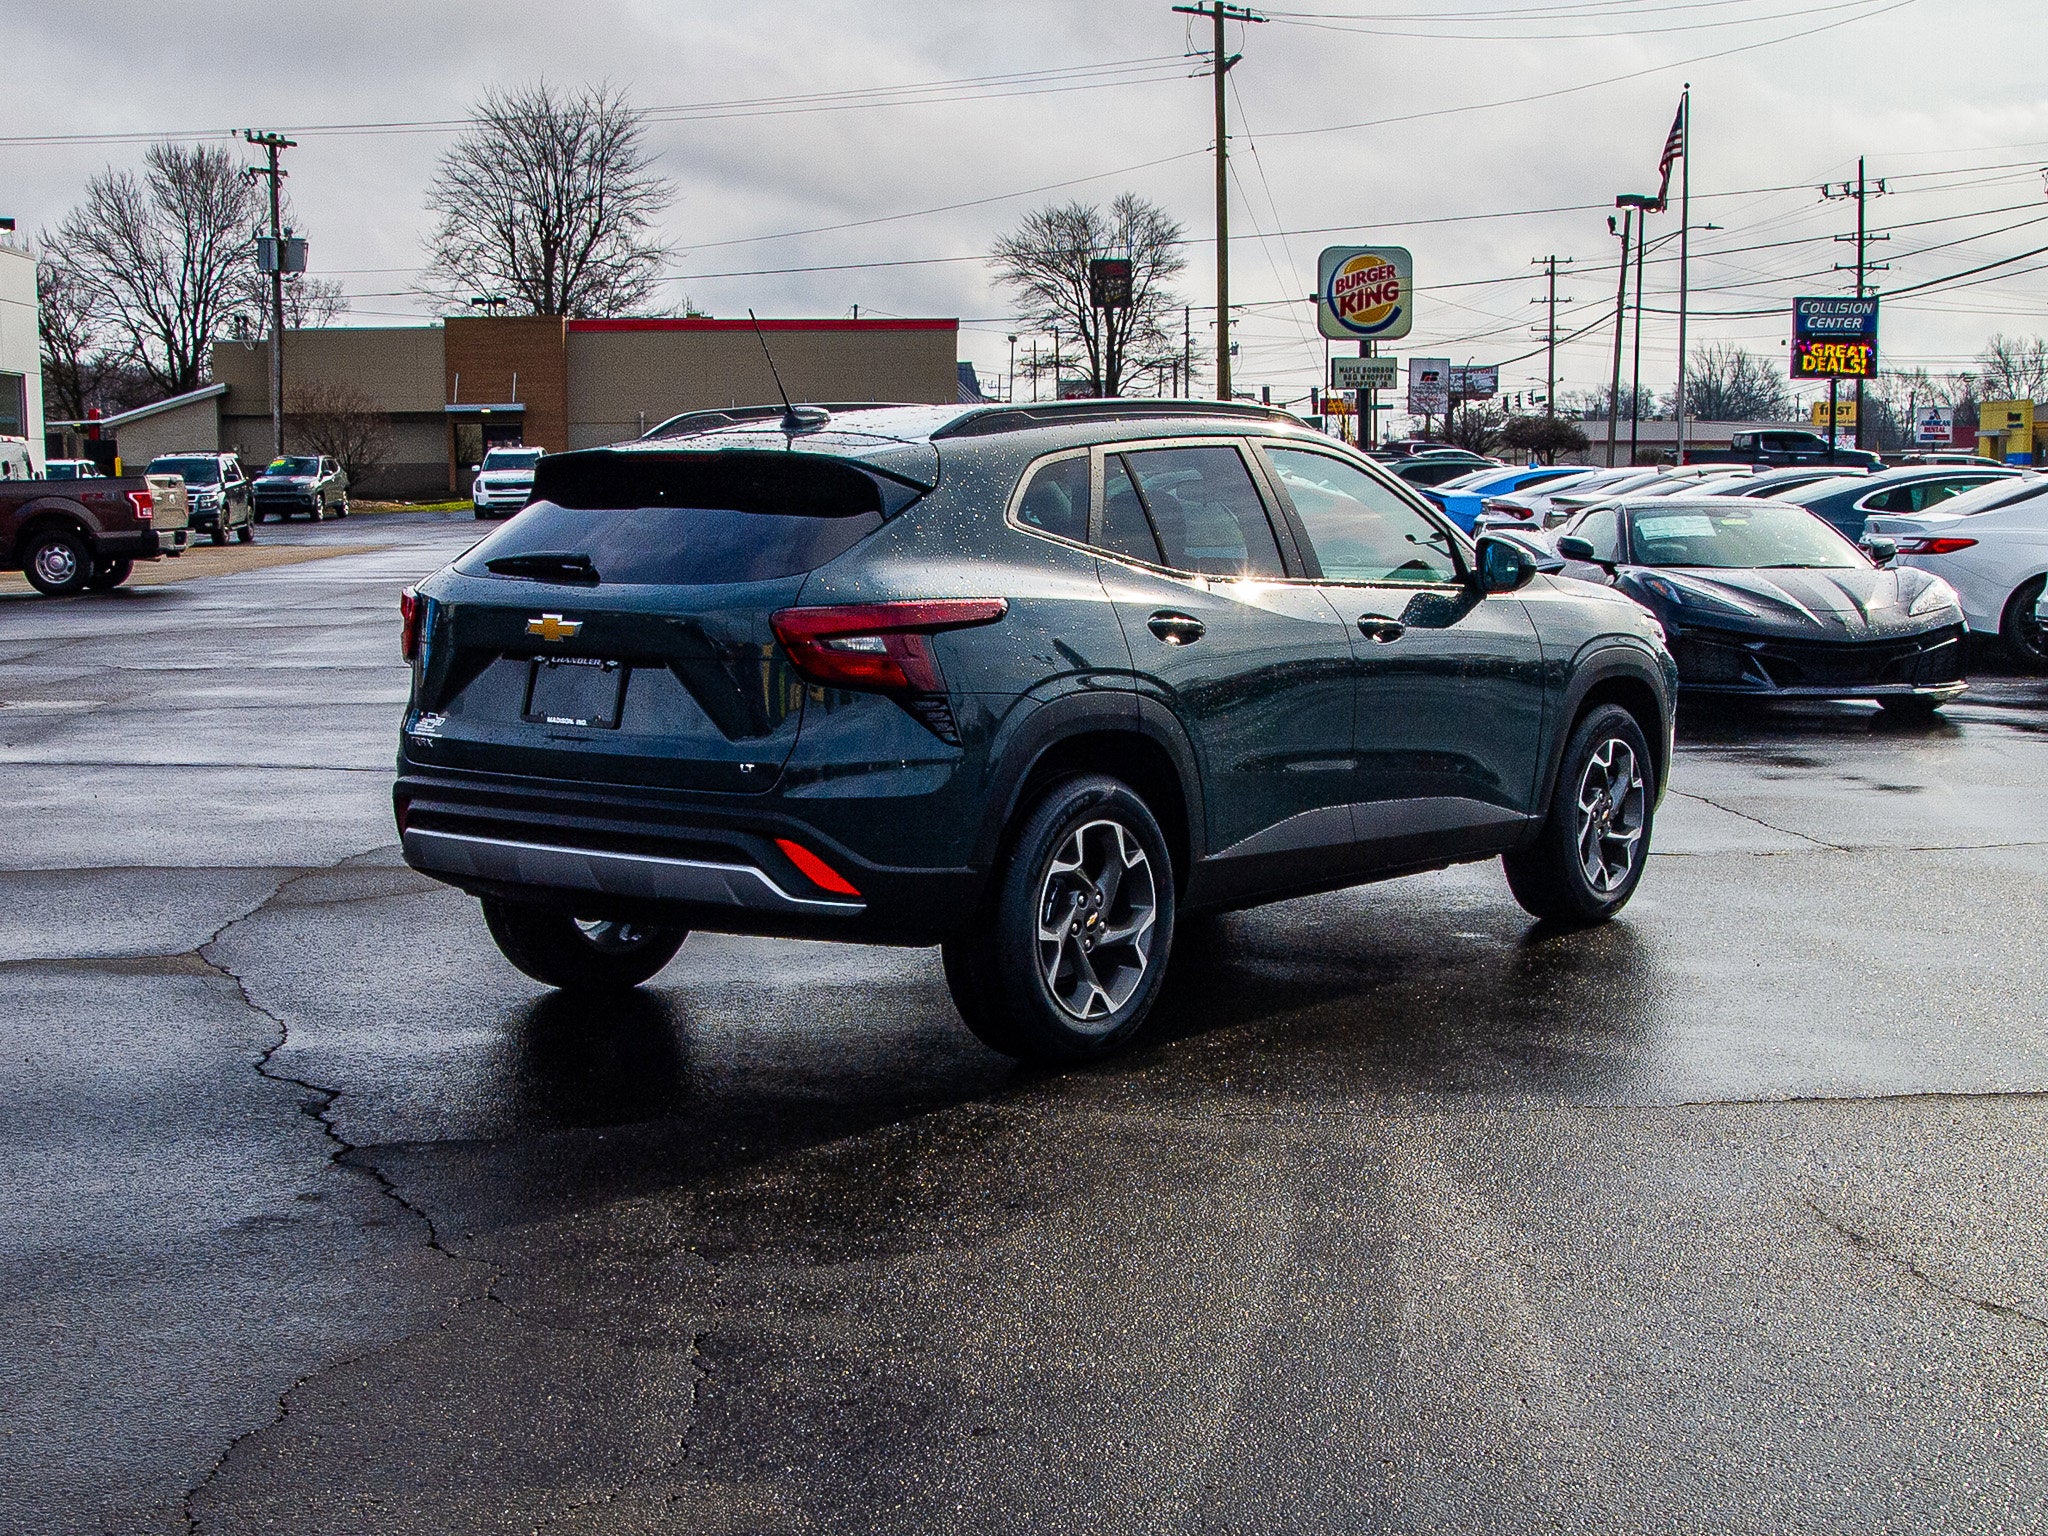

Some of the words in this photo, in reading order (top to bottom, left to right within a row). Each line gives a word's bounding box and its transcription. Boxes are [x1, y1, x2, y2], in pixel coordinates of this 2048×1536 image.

[1335, 264, 1396, 295] BURGER
[1340, 280, 1399, 318] KING
[1800, 301, 1873, 314] COLLISION
[1807, 316, 1863, 329] CENTER
[1811, 343, 1869, 358] GREAT
[1802, 354, 1867, 375] DEALS!
[551, 656, 602, 666] CHANDLER
[740, 763, 755, 773] LT
